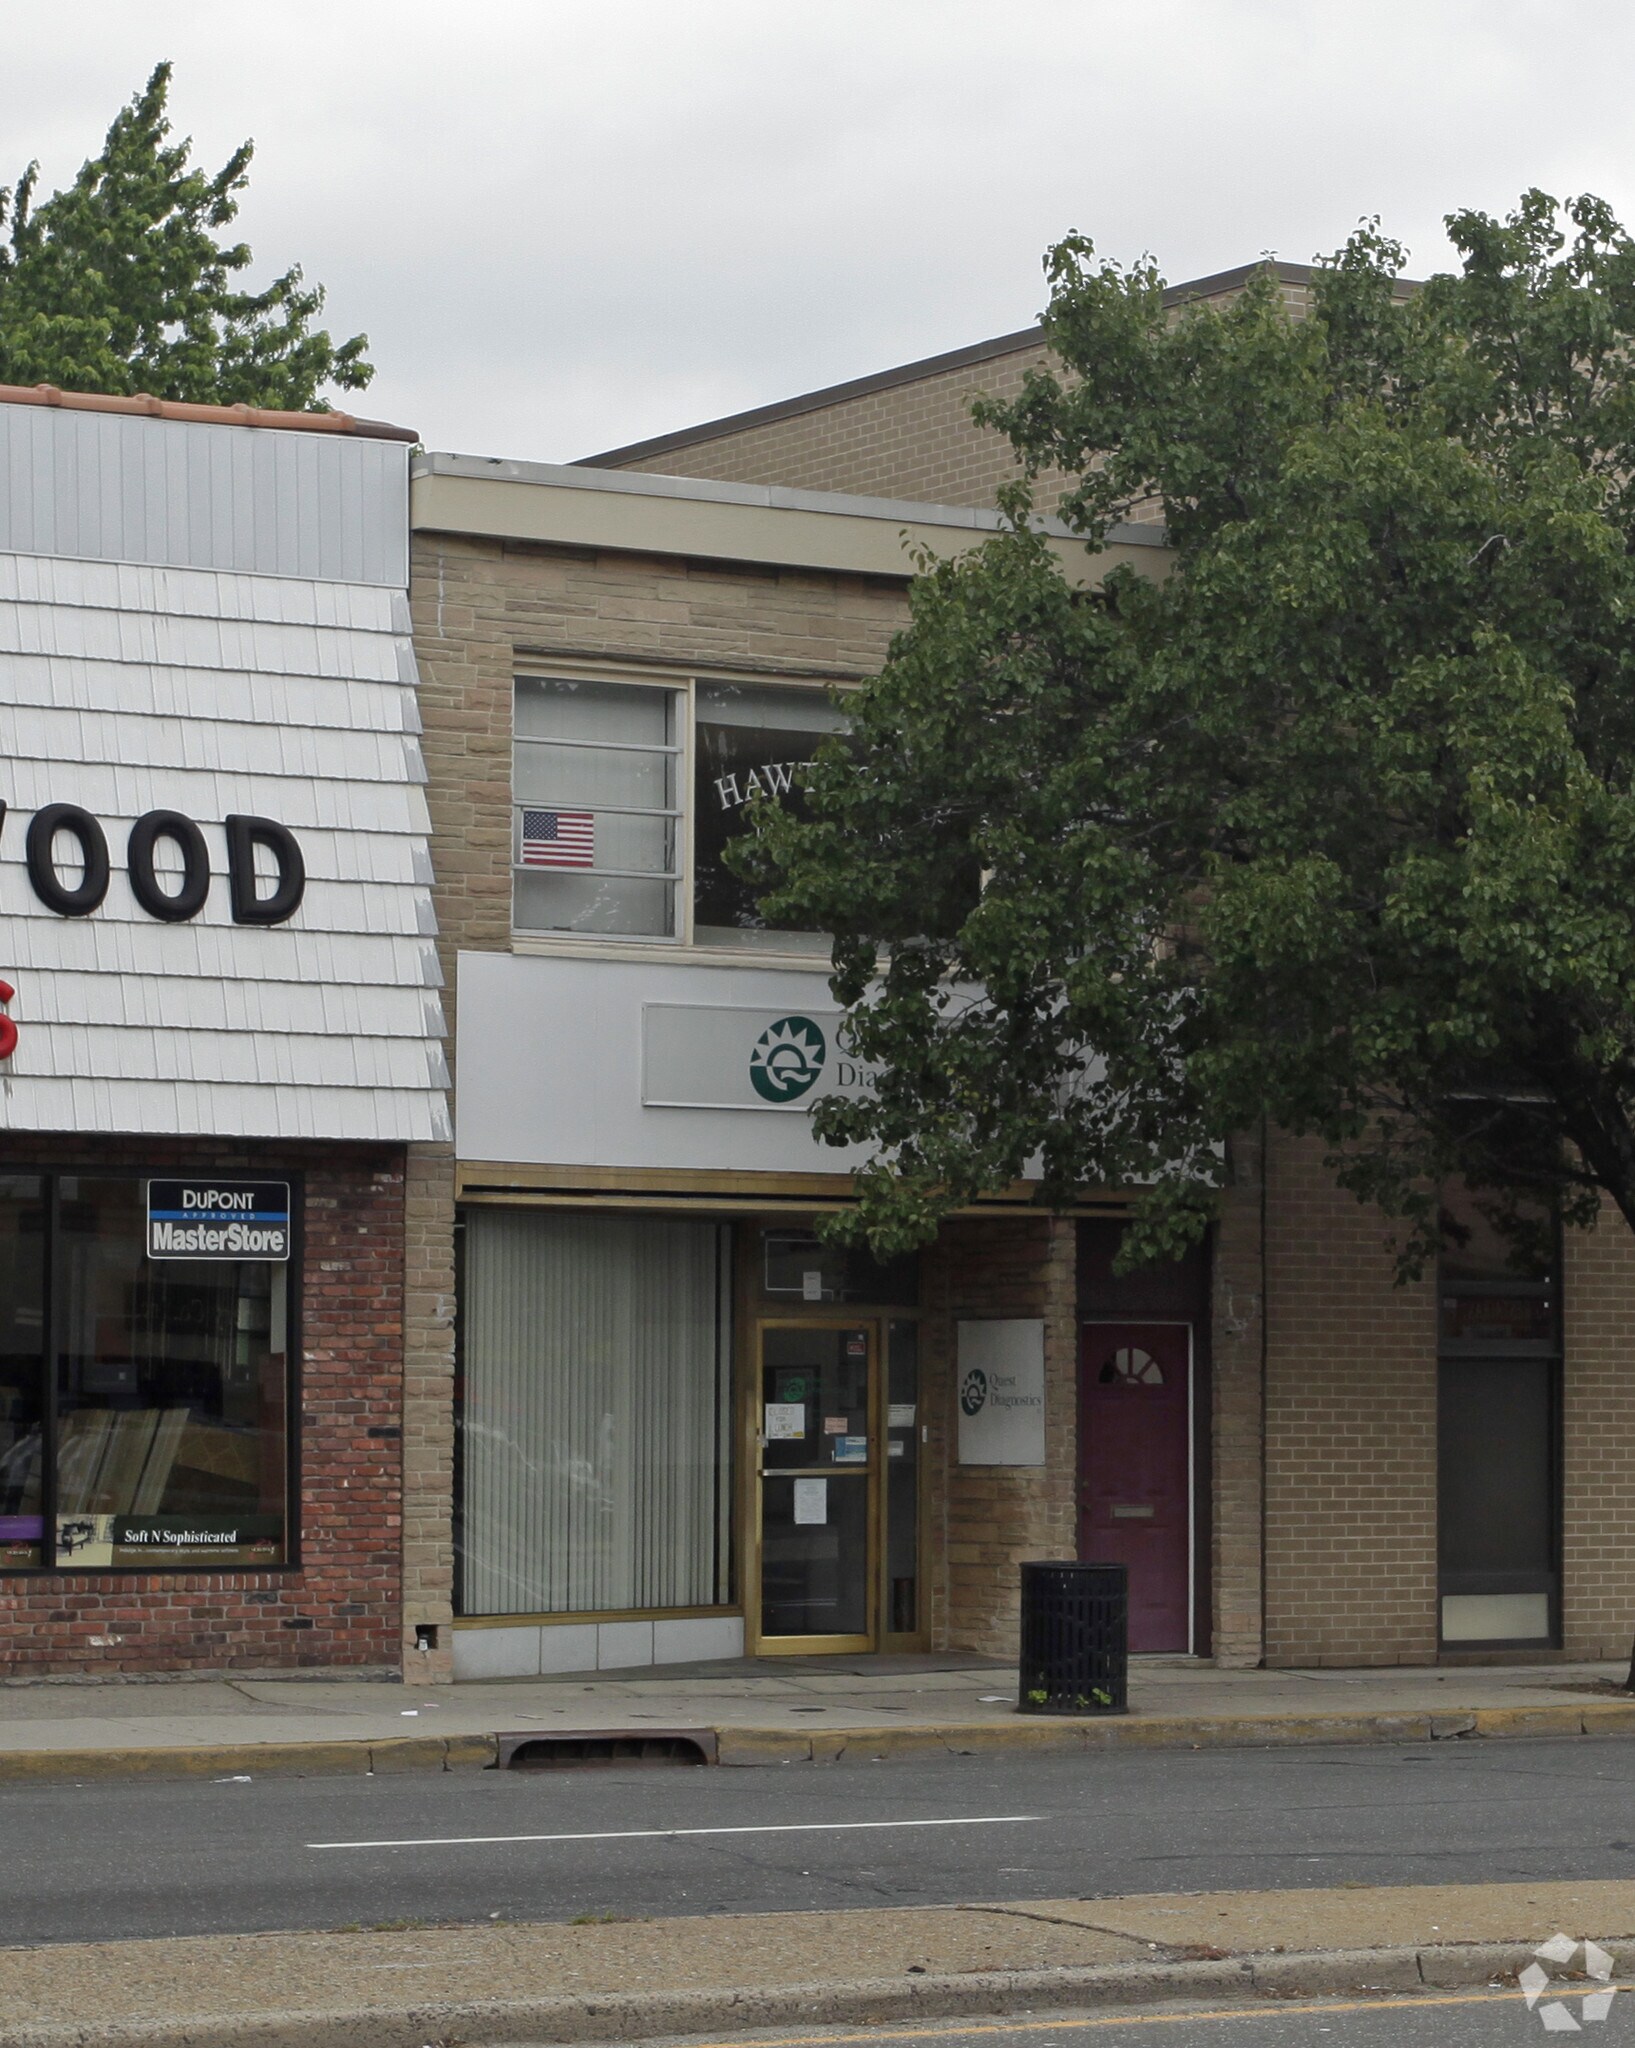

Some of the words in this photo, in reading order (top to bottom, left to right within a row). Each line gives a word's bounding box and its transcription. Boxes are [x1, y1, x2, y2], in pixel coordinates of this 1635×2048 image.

[0, 799, 306, 925] OOD
[182, 1189, 255, 1210] DUPONT
[182, 1212, 256, 1220] APPROVED
[153, 1222, 285, 1251] MasterStore
[989, 1372, 1016, 1391] Quest
[990, 1392, 1042, 1410] Diagnostics
[124, 1529, 148, 1543] Soft
[163, 1529, 237, 1546] Sophisticated
